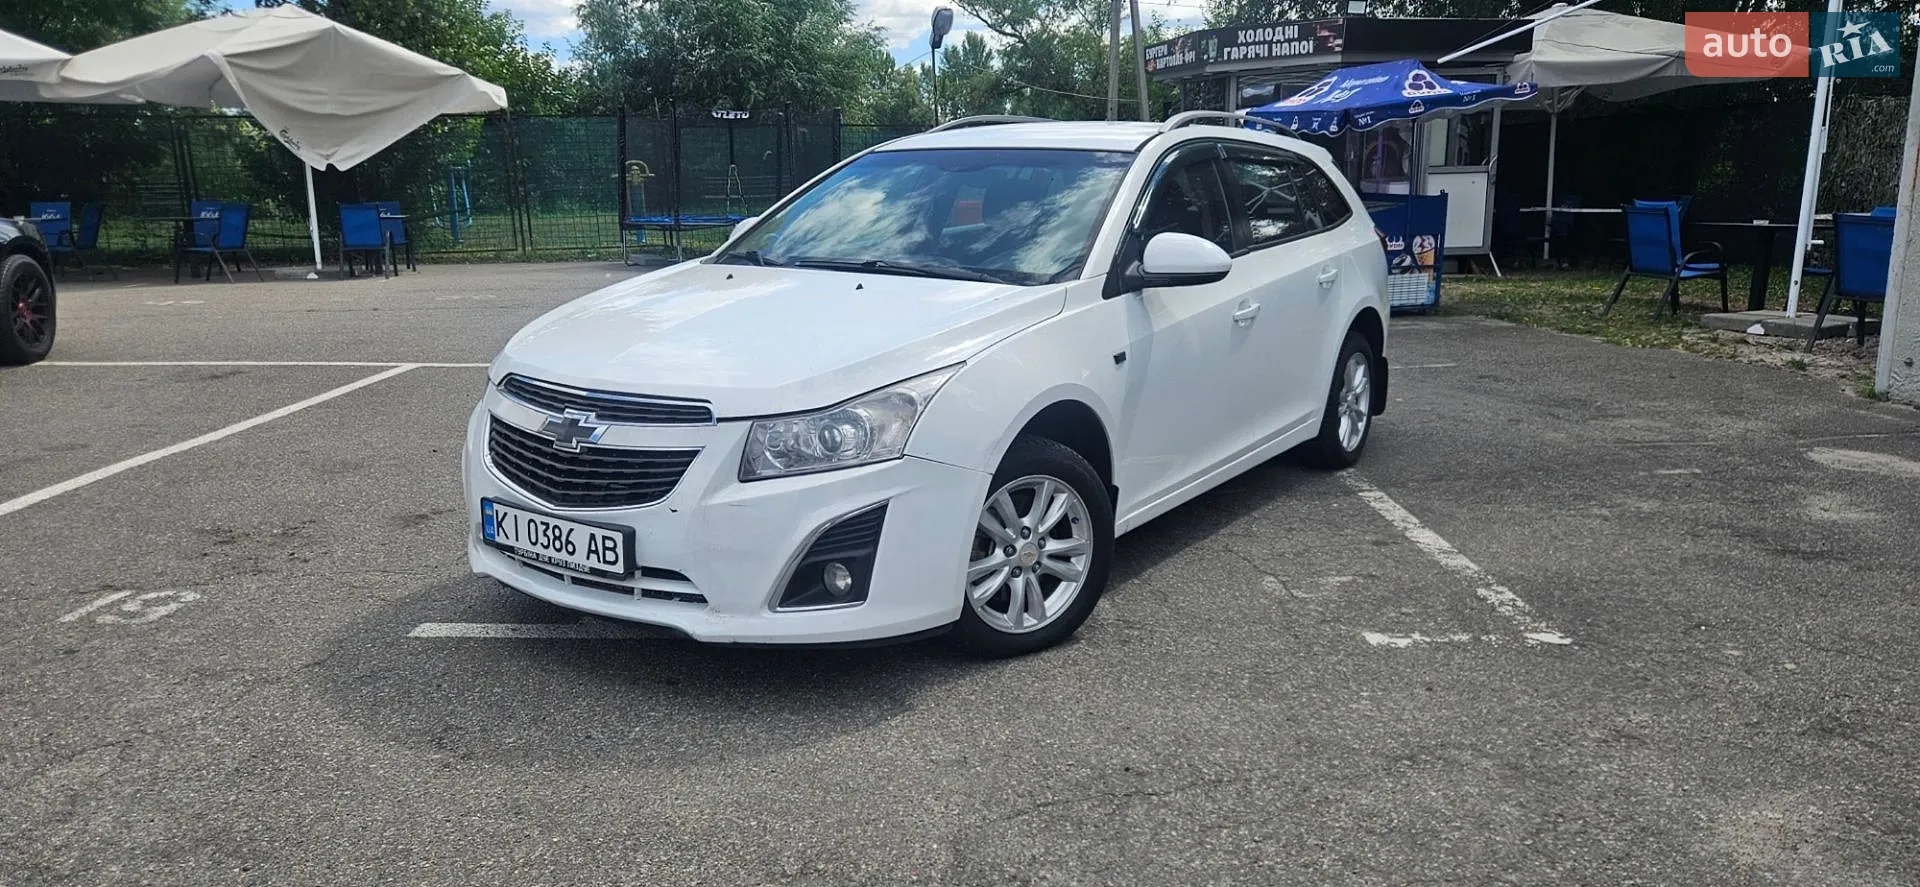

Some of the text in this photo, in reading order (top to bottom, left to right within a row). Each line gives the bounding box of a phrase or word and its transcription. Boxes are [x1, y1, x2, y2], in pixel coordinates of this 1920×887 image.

[1237, 25, 1299, 44] ХОЛОДНІ
[1223, 36, 1314, 61] ГАРЯЧІ НАПОЇ
[495, 509, 619, 566] KI 0386 AB
